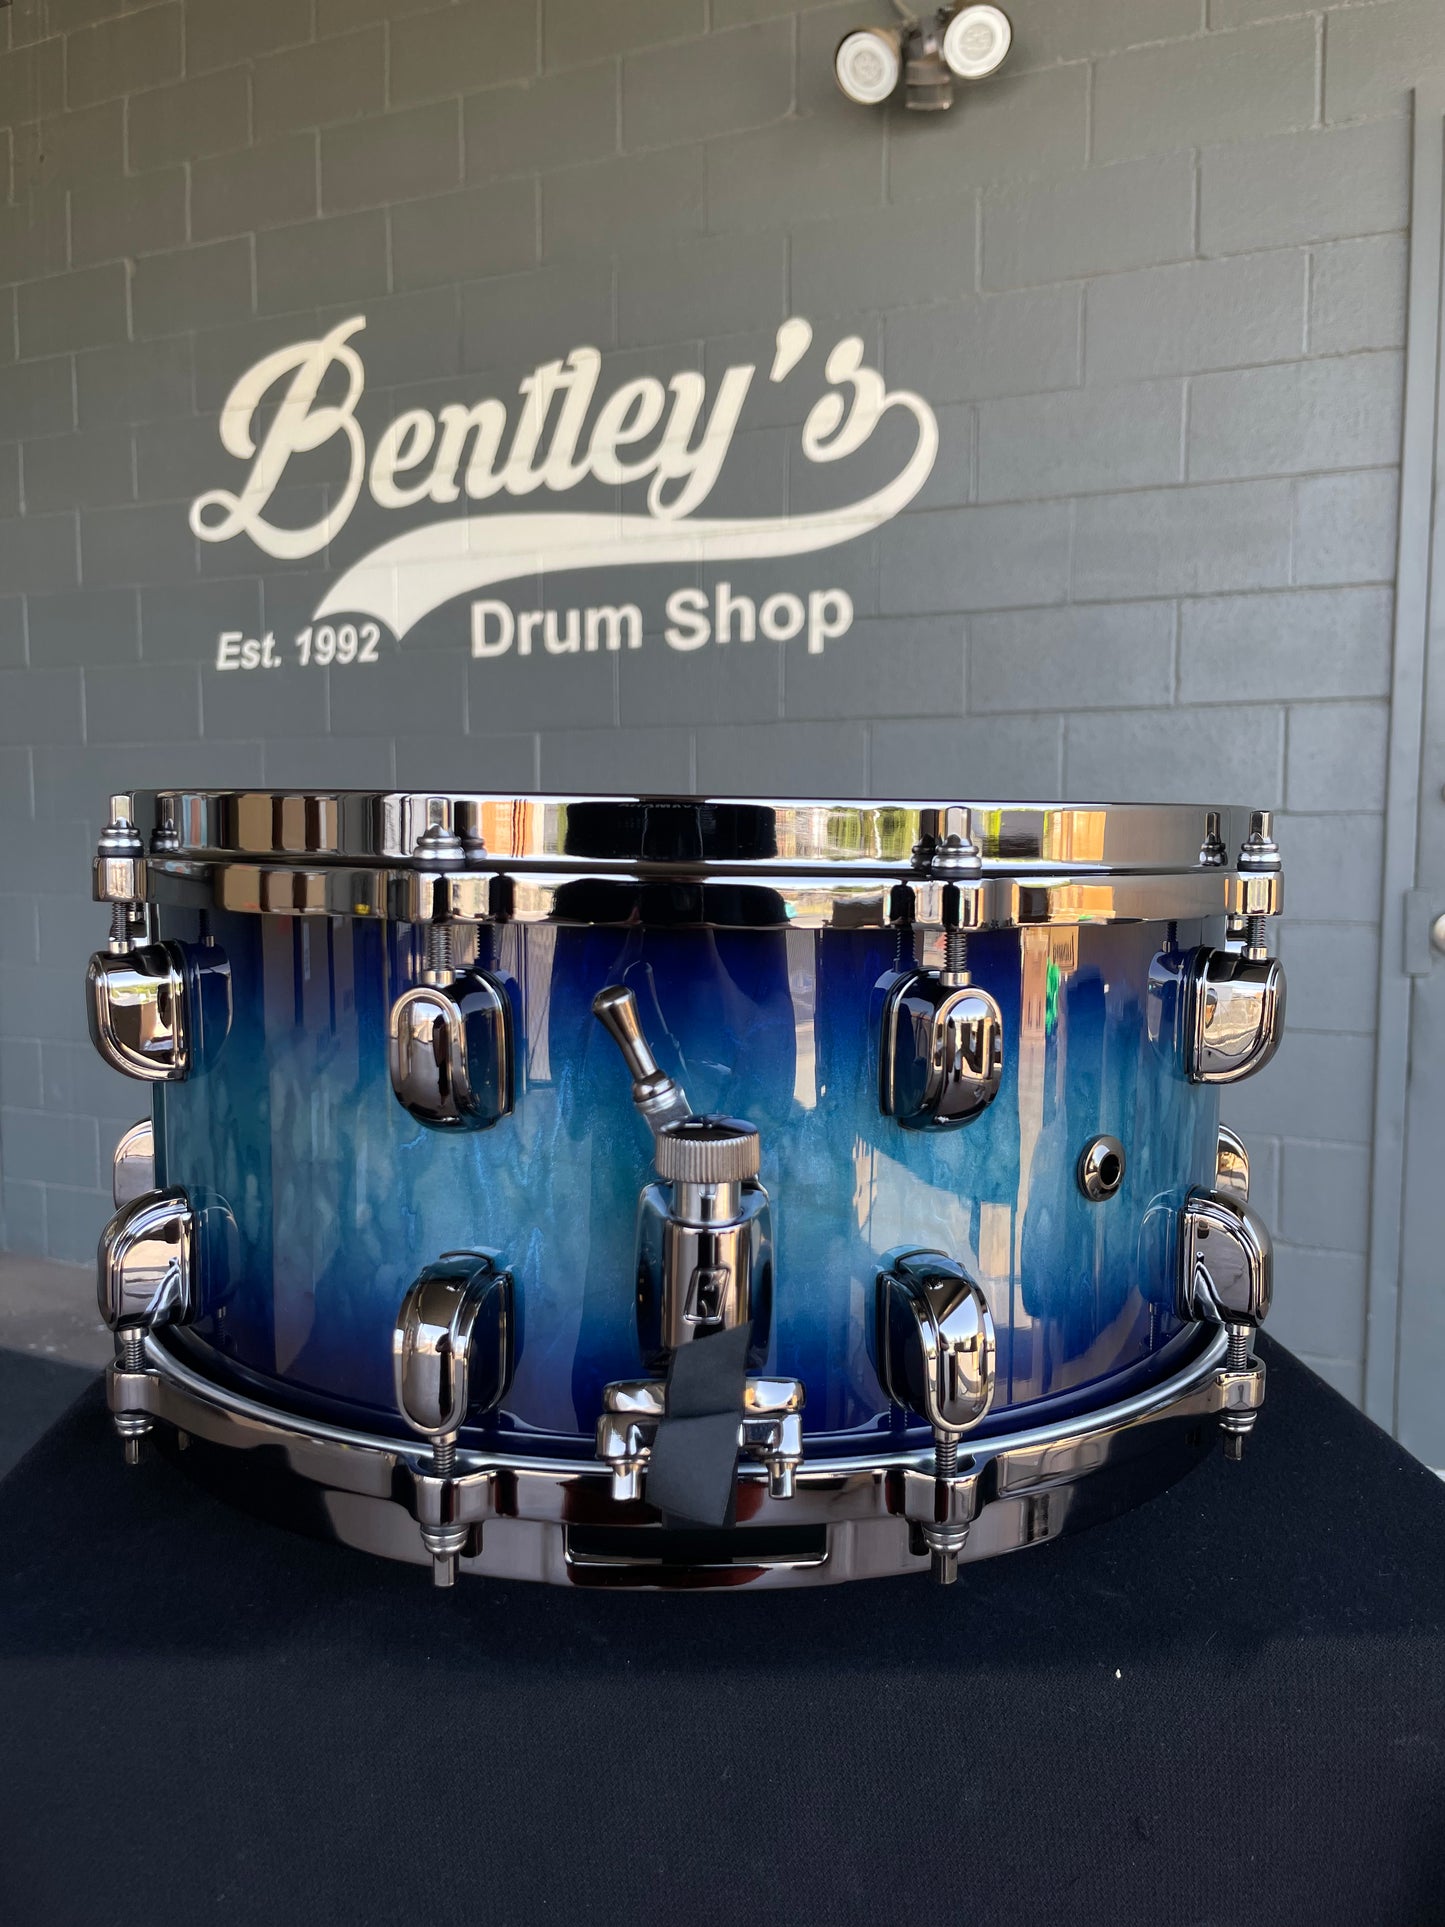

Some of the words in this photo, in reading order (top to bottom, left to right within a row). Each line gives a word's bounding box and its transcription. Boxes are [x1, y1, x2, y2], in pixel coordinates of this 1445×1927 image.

[189, 315, 939, 560] Bentley's
[215, 630, 282, 671] Est.
[295, 622, 381, 667] 1992
[471, 600, 644, 658] Drum
[664, 582, 854, 655] Shop
